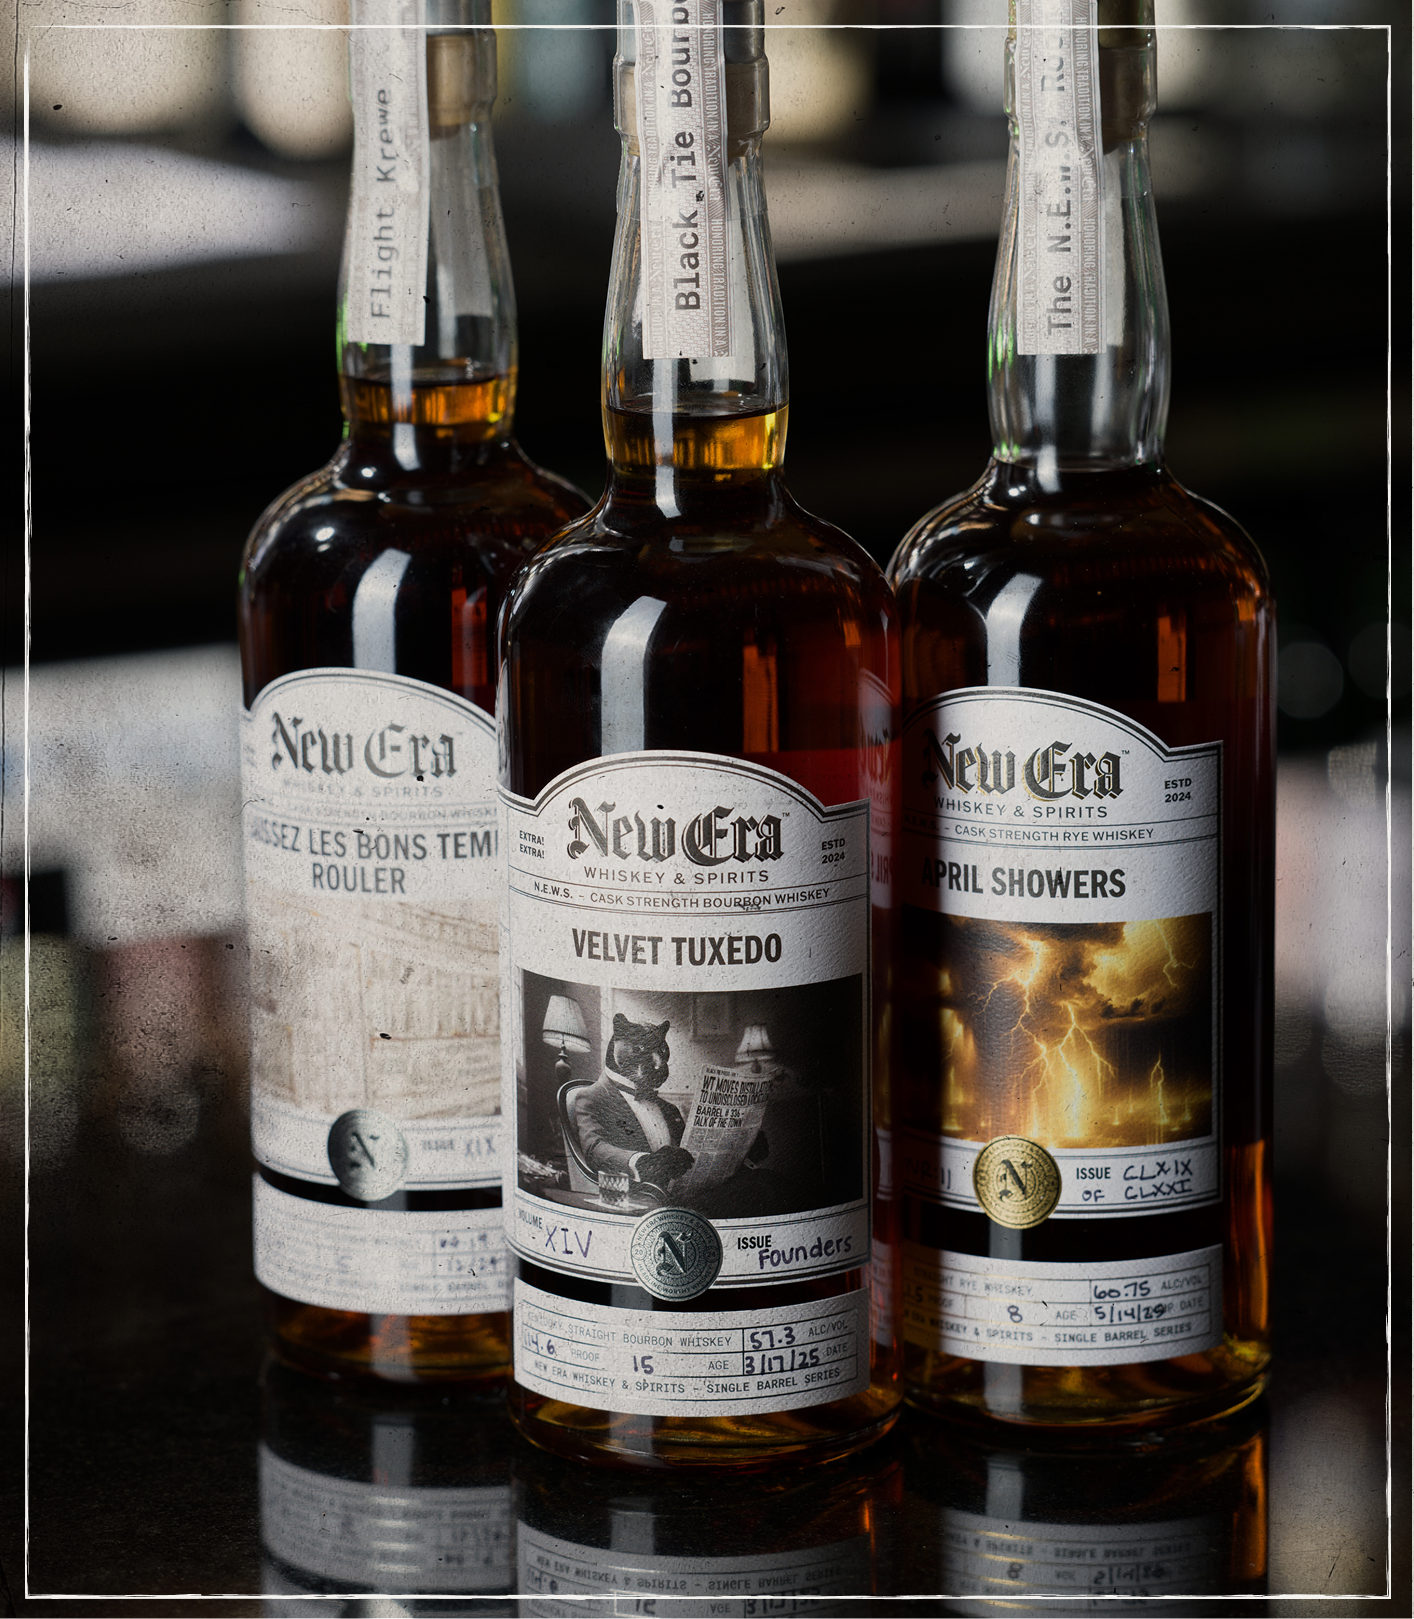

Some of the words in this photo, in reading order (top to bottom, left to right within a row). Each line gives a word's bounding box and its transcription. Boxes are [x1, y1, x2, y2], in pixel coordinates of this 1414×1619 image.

[703, 13, 716, 64] HONORING
[1075, 16, 1089, 67] HONORING
[665, 0, 692, 108] Bourb
[703, 66, 719, 117] TRADITION
[1076, 69, 1090, 120] TRADITION
[376, 89, 396, 183] Krewe
[706, 120, 719, 131] IN
[1079, 122, 1091, 133] IN
[670, 132, 696, 190] Tie
[711, 218, 725, 270] HONORING
[1082, 218, 1096, 268] HONORING
[371, 205, 399, 318] Flight
[672, 209, 700, 310] Black
[713, 272, 727, 320] TRADITION
[1046, 275, 1072, 336] The
[1083, 272, 1097, 321] TRADITION
[715, 325, 727, 336] IN
[272, 712, 353, 776] New
[364, 723, 458, 778] Era
[922, 727, 1016, 797] New
[372, 786, 443, 798] SPIRITS
[1164, 778, 1192, 790] ESTD
[933, 795, 1007, 817] WHISKEY
[1013, 805, 1025, 818] &
[1032, 806, 1108, 819] SPIRITS
[1164, 791, 1192, 803] 2024
[519, 829, 545, 846] EXTRA!
[567, 797, 675, 863] New
[954, 824, 987, 839] CASK
[989, 828, 1060, 842] STRENGTH
[1063, 830, 1090, 842] RYE
[1092, 828, 1155, 841] WHISKEY
[309, 828, 346, 858] LES
[357, 833, 428, 860] BONS
[436, 830, 498, 860] TEM
[519, 843, 545, 860] EXTRA!
[821, 838, 846, 851] ESTD
[821, 851, 846, 864] 2024
[312, 863, 406, 894] ROULER
[583, 866, 665, 884] WHISKEY
[675, 872, 686, 885] &
[694, 869, 769, 885] SPIRITS
[921, 855, 983, 894] APRIL
[991, 867, 1126, 899] SHOWERS
[534, 881, 573, 899] N.E.W.S.
[590, 892, 624, 906] CASK
[626, 895, 699, 909] STRENGTH
[703, 895, 772, 909] BOURBON
[775, 887, 830, 905] WHISKEY
[572, 928, 663, 965] VELVET
[671, 932, 783, 966] TUXEDO
[700, 1089, 709, 1103] TO
[708, 1092, 748, 1106] UNDISCLOSED
[715, 1078, 739, 1094] MOVES
[693, 1115, 709, 1127] TALK
[709, 1117, 717, 1127] OF
[717, 1118, 728, 1128] THE
[728, 1118, 742, 1128] TOWN
[696, 1105, 723, 1117] BARREL
[1076, 1167, 1111, 1180] ISSUE
[1123, 1159, 1192, 1181] CLXIX
[1125, 1179, 1192, 1200] CLXXI
[518, 1208, 543, 1230] VOLUME
[637, 1228, 647, 1241] NEW
[646, 1218, 658, 1229] ERA
[656, 1214, 689, 1222] WHISKEY
[694, 1222, 714, 1243] SPIRITS
[545, 1225, 593, 1258] XIV
[737, 1235, 772, 1250] ISSUE
[758, 1235, 852, 1270] Founders
[691, 1266, 713, 1290] WHISKEY
[960, 1279, 977, 1291] RYE
[984, 1283, 1032, 1296] WHISKEY
[1161, 1275, 1202, 1291] ALC/VOL
[1094, 1281, 1151, 1299] 60.75
[1007, 1305, 1023, 1323] 8
[1055, 1310, 1077, 1321] AGE
[1180, 1298, 1204, 1311] DATE
[568, 1324, 616, 1341] STRAIGHT
[623, 1334, 673, 1347] BOURBON
[680, 1336, 732, 1347] WHISKEY
[750, 1326, 796, 1350] 57.3
[808, 1320, 848, 1338] ALC/VOL
[974, 1327, 980, 1336] &
[986, 1329, 1033, 1341] SPIRITS
[1054, 1332, 1097, 1344] SINGLE
[1104, 1329, 1148, 1342] BARREL
[1153, 1321, 1192, 1337] SERIES
[524, 1330, 555, 1355] 114.6
[825, 1342, 848, 1357] DATE
[571, 1348, 600, 1362] PROOF
[633, 1356, 654, 1375] 15
[708, 1360, 729, 1370] AGE
[745, 1347, 820, 1376] 3/17/25
[535, 1360, 547, 1373] NEW
[552, 1366, 567, 1379] ERA
[573, 1369, 615, 1388] WHISKEY
[622, 1380, 629, 1389] &
[635, 1381, 685, 1393] SPIRITS
[707, 1381, 750, 1394] SINGLE
[756, 1377, 798, 1391] BARREL
[804, 1367, 841, 1384] SERIES
